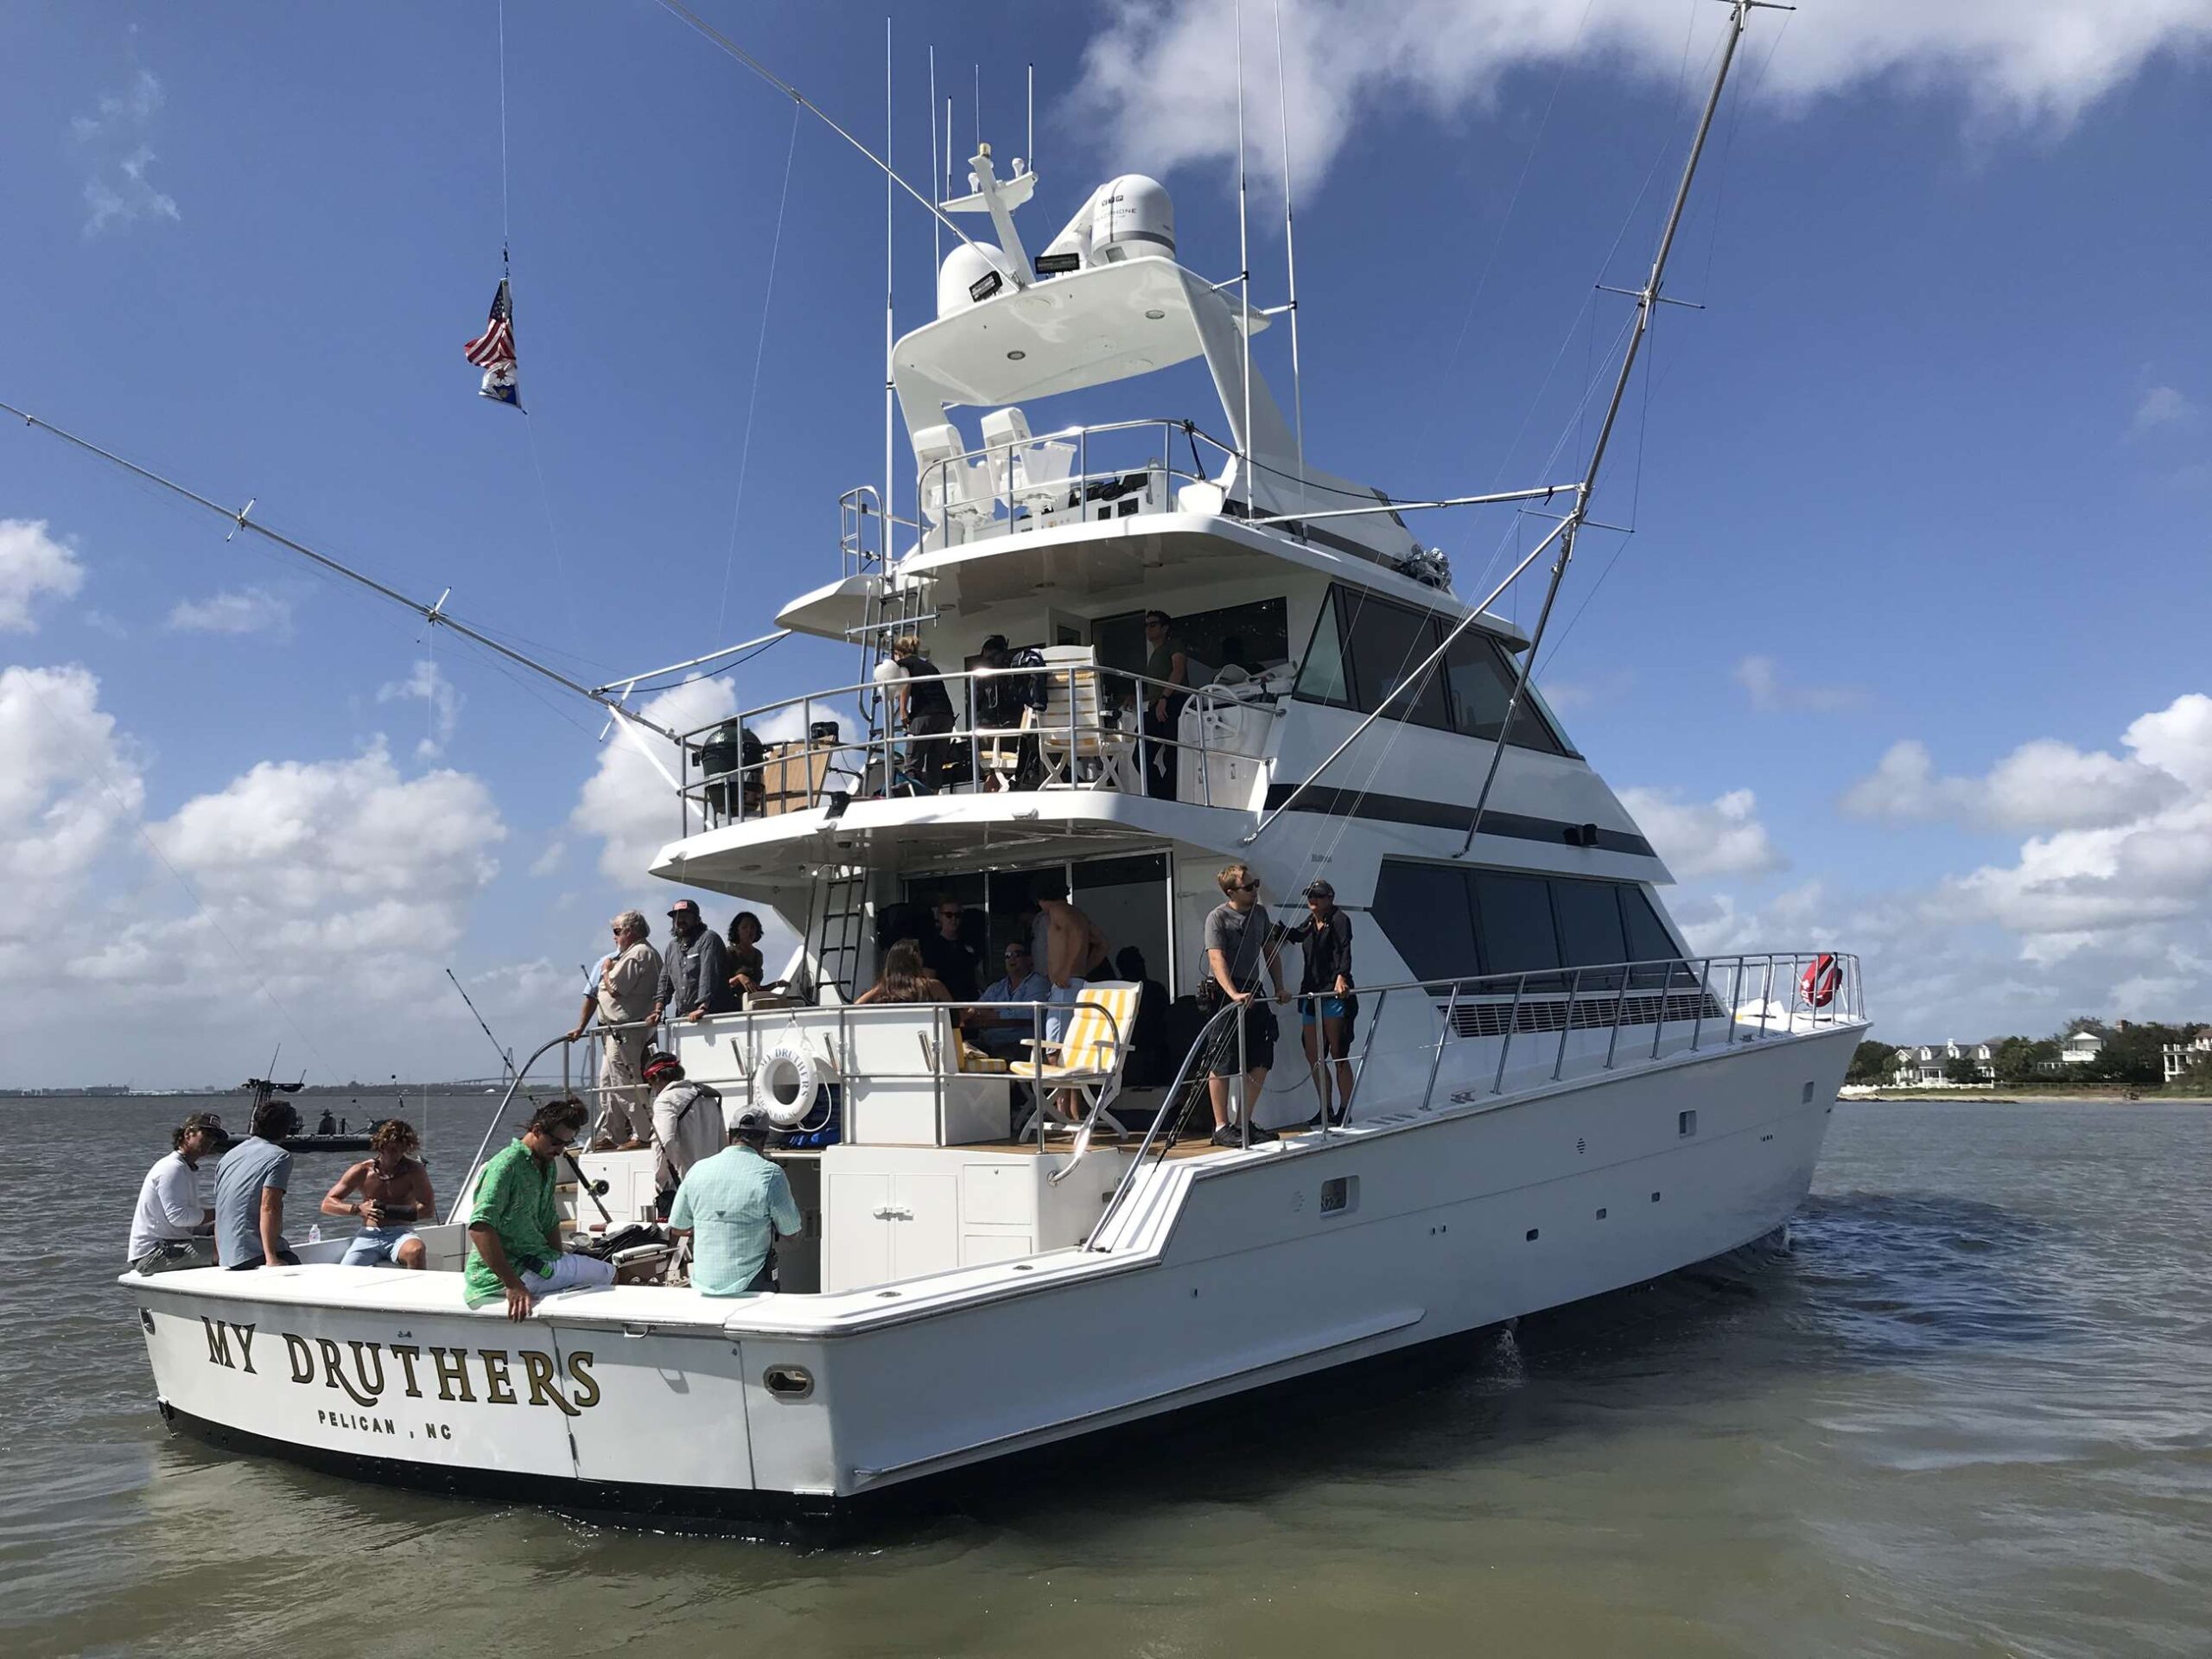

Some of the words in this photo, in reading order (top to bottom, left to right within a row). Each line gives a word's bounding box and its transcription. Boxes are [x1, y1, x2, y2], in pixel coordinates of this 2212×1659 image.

[775, 1048, 810, 1097] DRUTHERS
[200, 1315, 257, 1375] MY
[282, 1332, 601, 1417] DRUTHERS
[317, 1409, 396, 1434] PELICAN
[426, 1423, 452, 1440] NC
